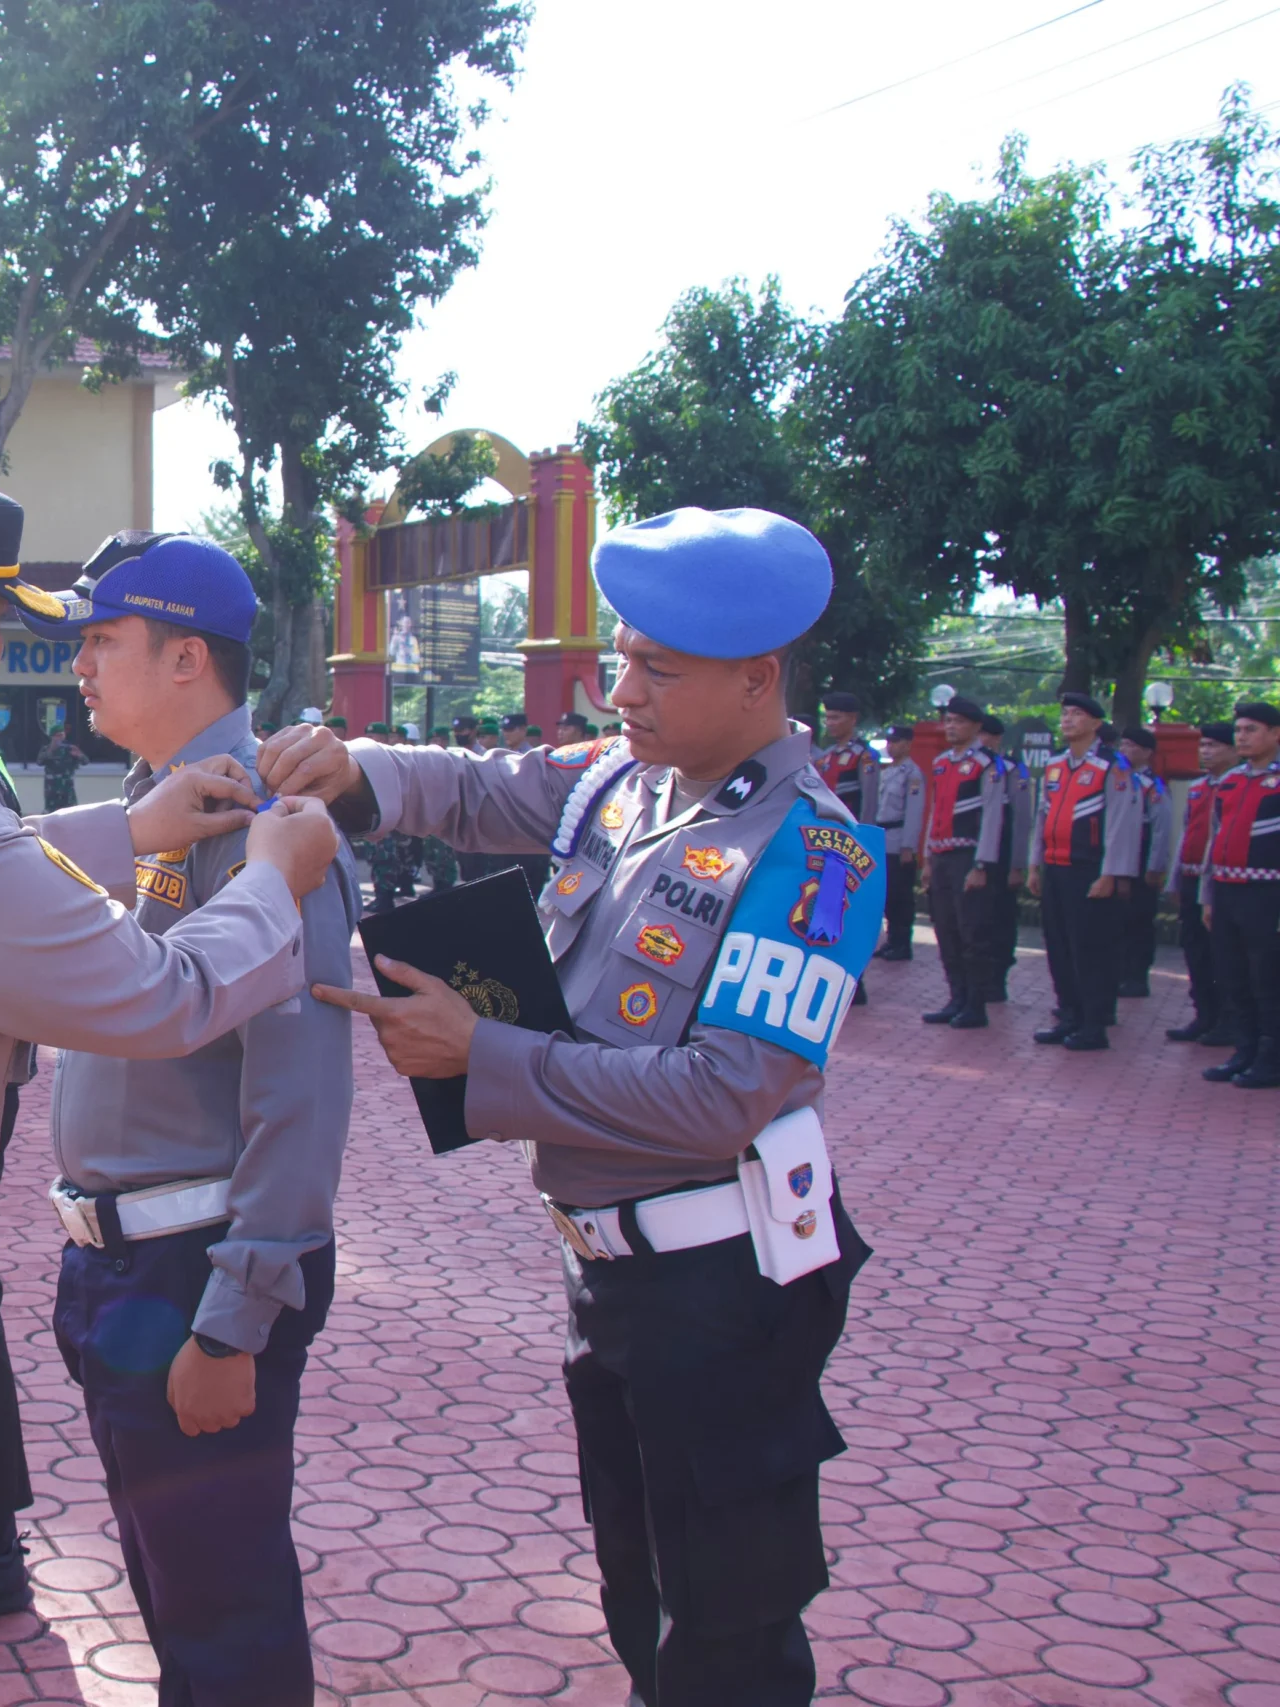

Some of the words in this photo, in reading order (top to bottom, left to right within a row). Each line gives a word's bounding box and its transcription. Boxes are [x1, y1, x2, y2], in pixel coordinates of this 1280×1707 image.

[123, 592, 164, 611] KABUPATEN
[166, 602, 195, 617] ASAHAN
[1022, 749, 1050, 768] VIP
[808, 829, 870, 867] POLRES
[815, 838, 865, 869] ASAHAN
[649, 873, 724, 927] POLRI
